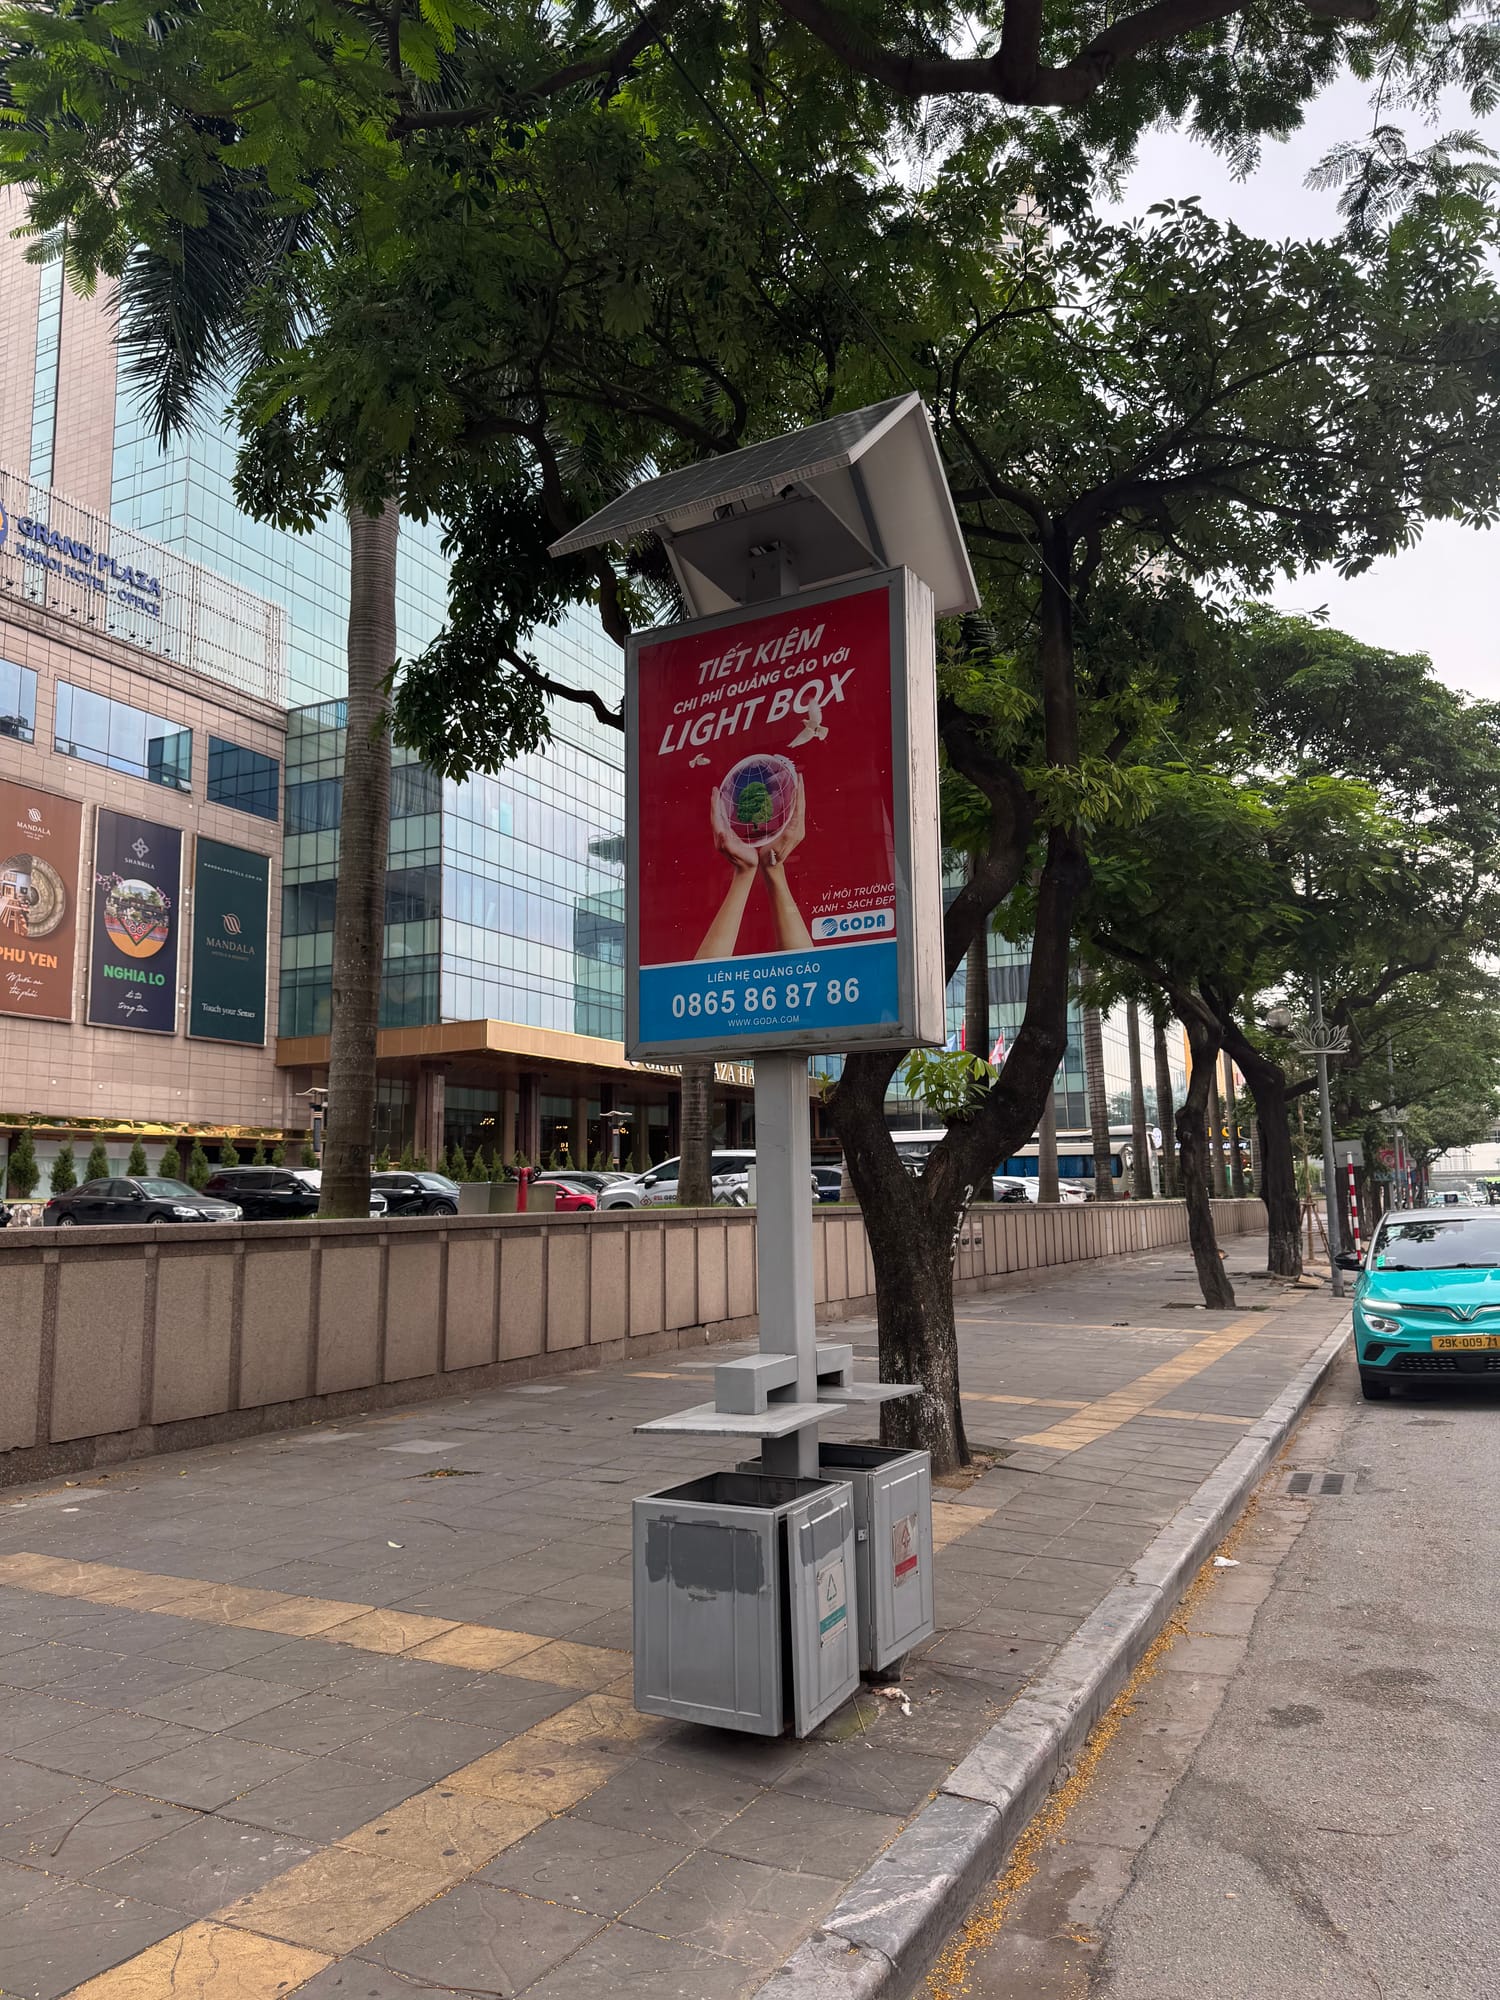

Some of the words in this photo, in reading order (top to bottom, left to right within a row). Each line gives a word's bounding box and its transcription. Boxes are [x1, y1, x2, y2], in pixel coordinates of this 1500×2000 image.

[17, 516, 94, 563] GRAND
[98, 552, 161, 598] PLAZA
[15, 541, 62, 573] HANOI
[64, 564, 106, 593] HOTEL
[118, 589, 160, 616] OFFICE
[698, 641, 753, 685] TIẾT
[752, 624, 826, 668] KIỆM
[673, 697, 698, 715] CHI
[700, 684, 727, 707] PHÍ
[727, 669, 780, 698] QUẢNG
[784, 657, 818, 681] CÁO
[822, 647, 851, 668] VỚI
[658, 696, 766, 755] LIGHT
[766, 668, 856, 724] BOX
[16, 821, 51, 836] MANDALA
[833, 888, 851, 899] MÔI
[854, 882, 895, 896] TRƯỜNG
[811, 903, 838, 914] XANH
[846, 898, 873, 911] SẠCH
[875, 895, 896, 906] ĐẸP
[839, 914, 886, 932] GODA
[206, 936, 255, 955] MANDALA
[28, 951, 58, 969] YEN
[103, 964, 147, 983] NGHIA
[149, 972, 166, 986] LO
[708, 971, 733, 983] LIÊN
[735, 969, 750, 982] HỆ
[753, 966, 793, 980] QUẢNG
[796, 962, 820, 975] CÁO
[672, 989, 736, 1018] 0865
[744, 986, 777, 1012] 86
[785, 982, 818, 1009] 87
[827, 977, 860, 1005] 86
[728, 1015, 800, 1027] WWW.GODA.COM
